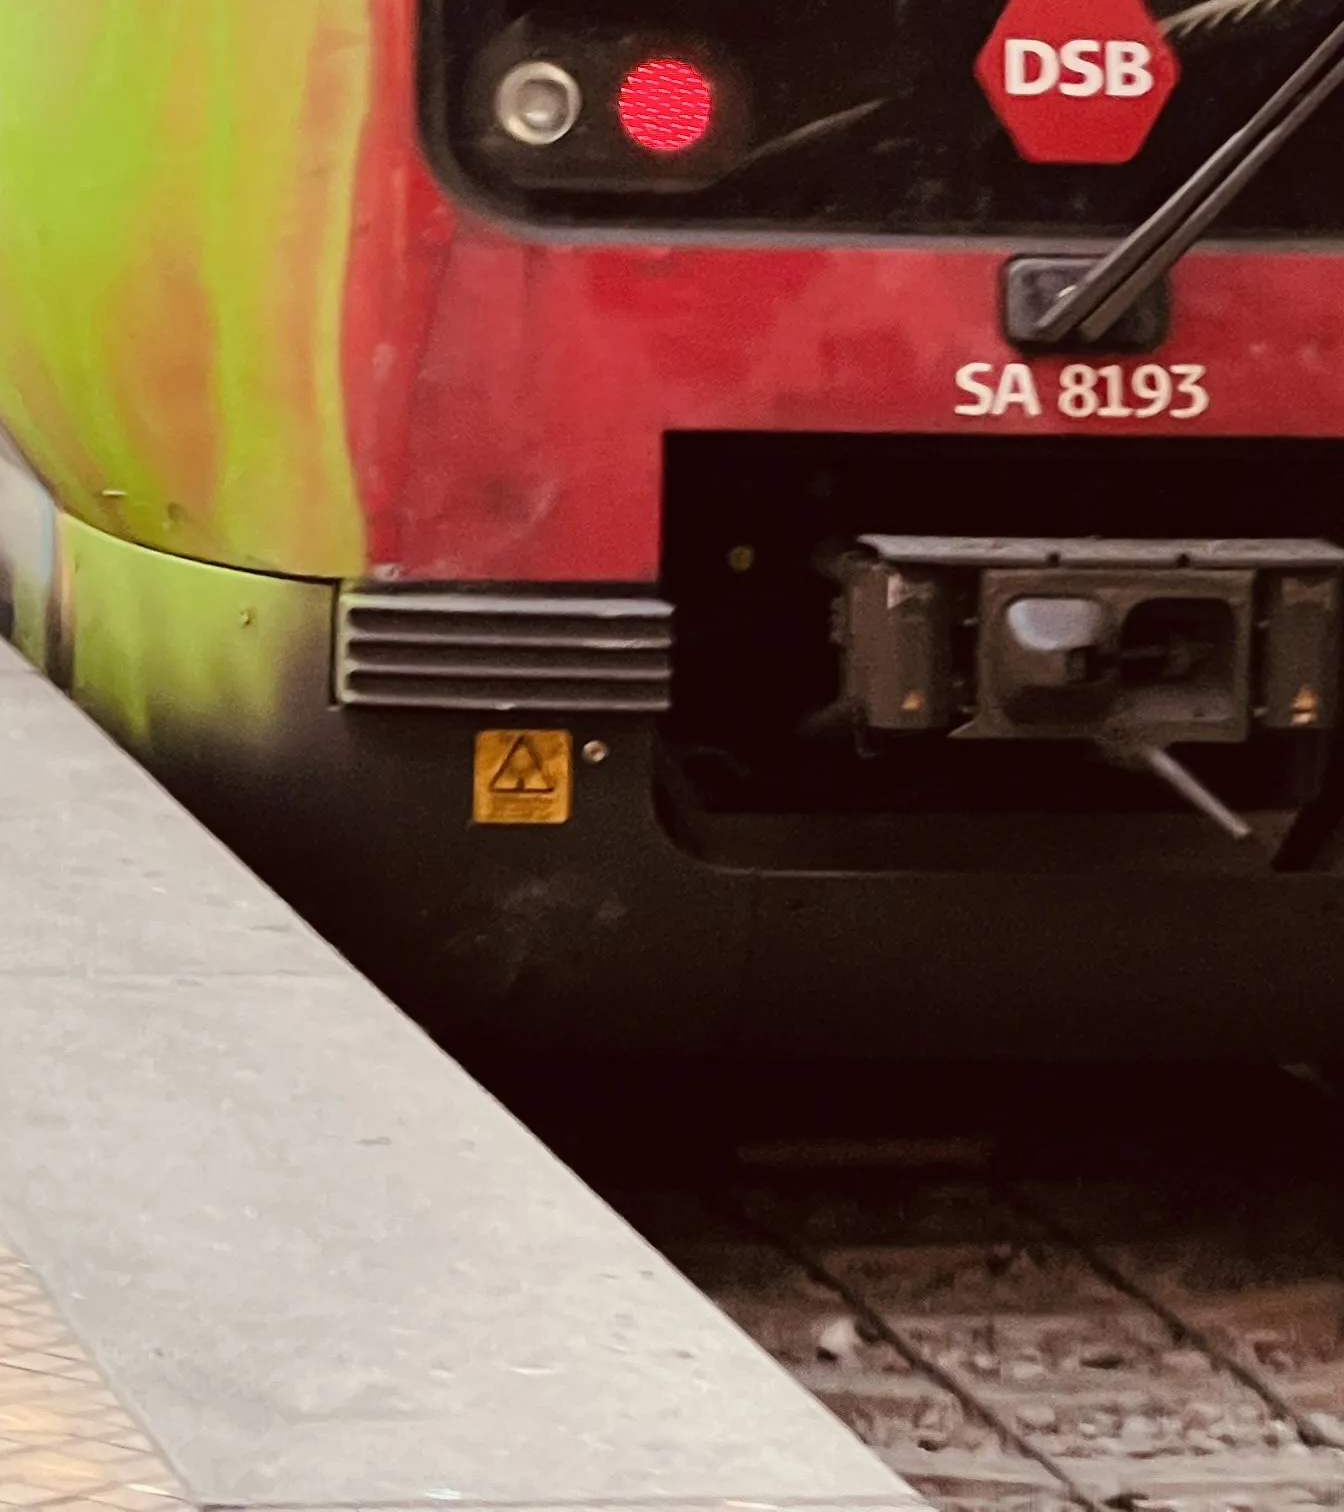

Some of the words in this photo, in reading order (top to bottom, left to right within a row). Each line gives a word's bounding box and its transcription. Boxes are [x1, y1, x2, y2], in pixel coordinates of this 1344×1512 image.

[1004, 38, 1154, 98] DSB
[954, 361, 1042, 417] SA
[1057, 363, 1210, 418] 8193
